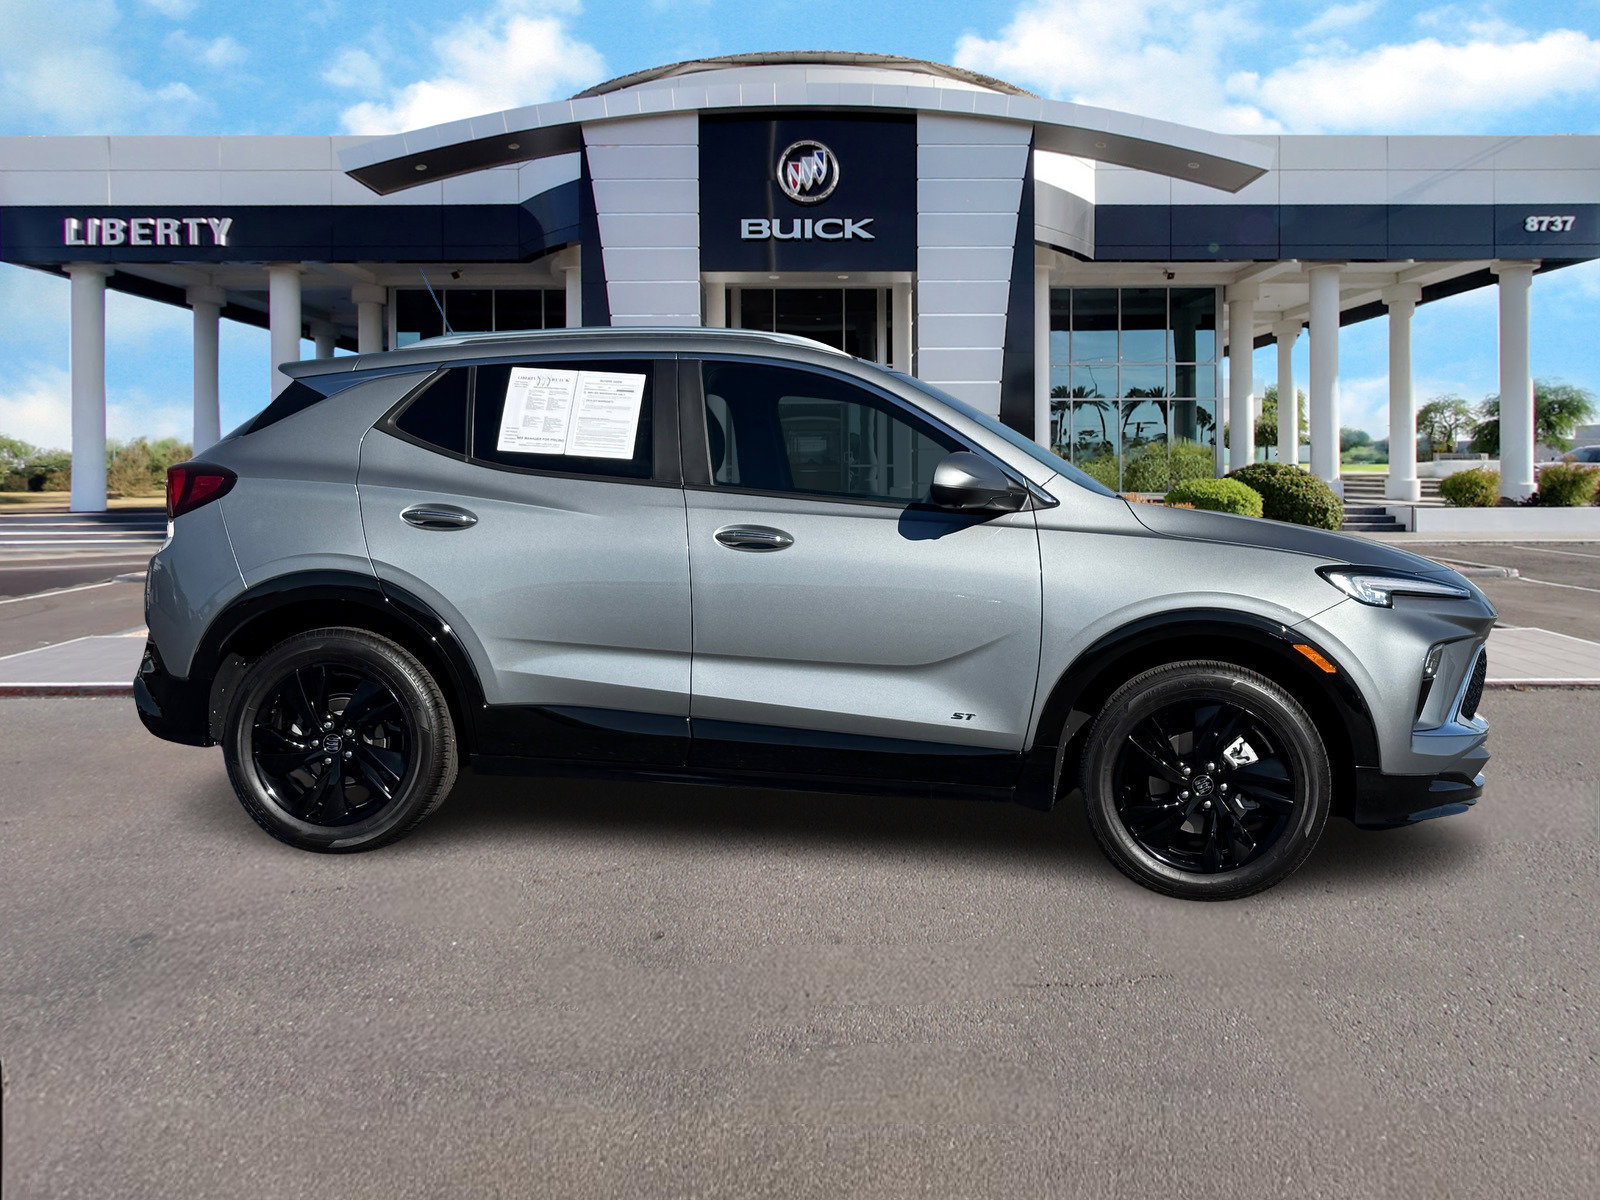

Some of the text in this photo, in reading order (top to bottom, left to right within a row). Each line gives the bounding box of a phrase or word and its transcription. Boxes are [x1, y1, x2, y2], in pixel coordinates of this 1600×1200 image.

[64, 217, 233, 246] LIBERTY
[740, 218, 876, 239] BUICK
[1524, 215, 1576, 232] 8737
[950, 712, 977, 721] ST
